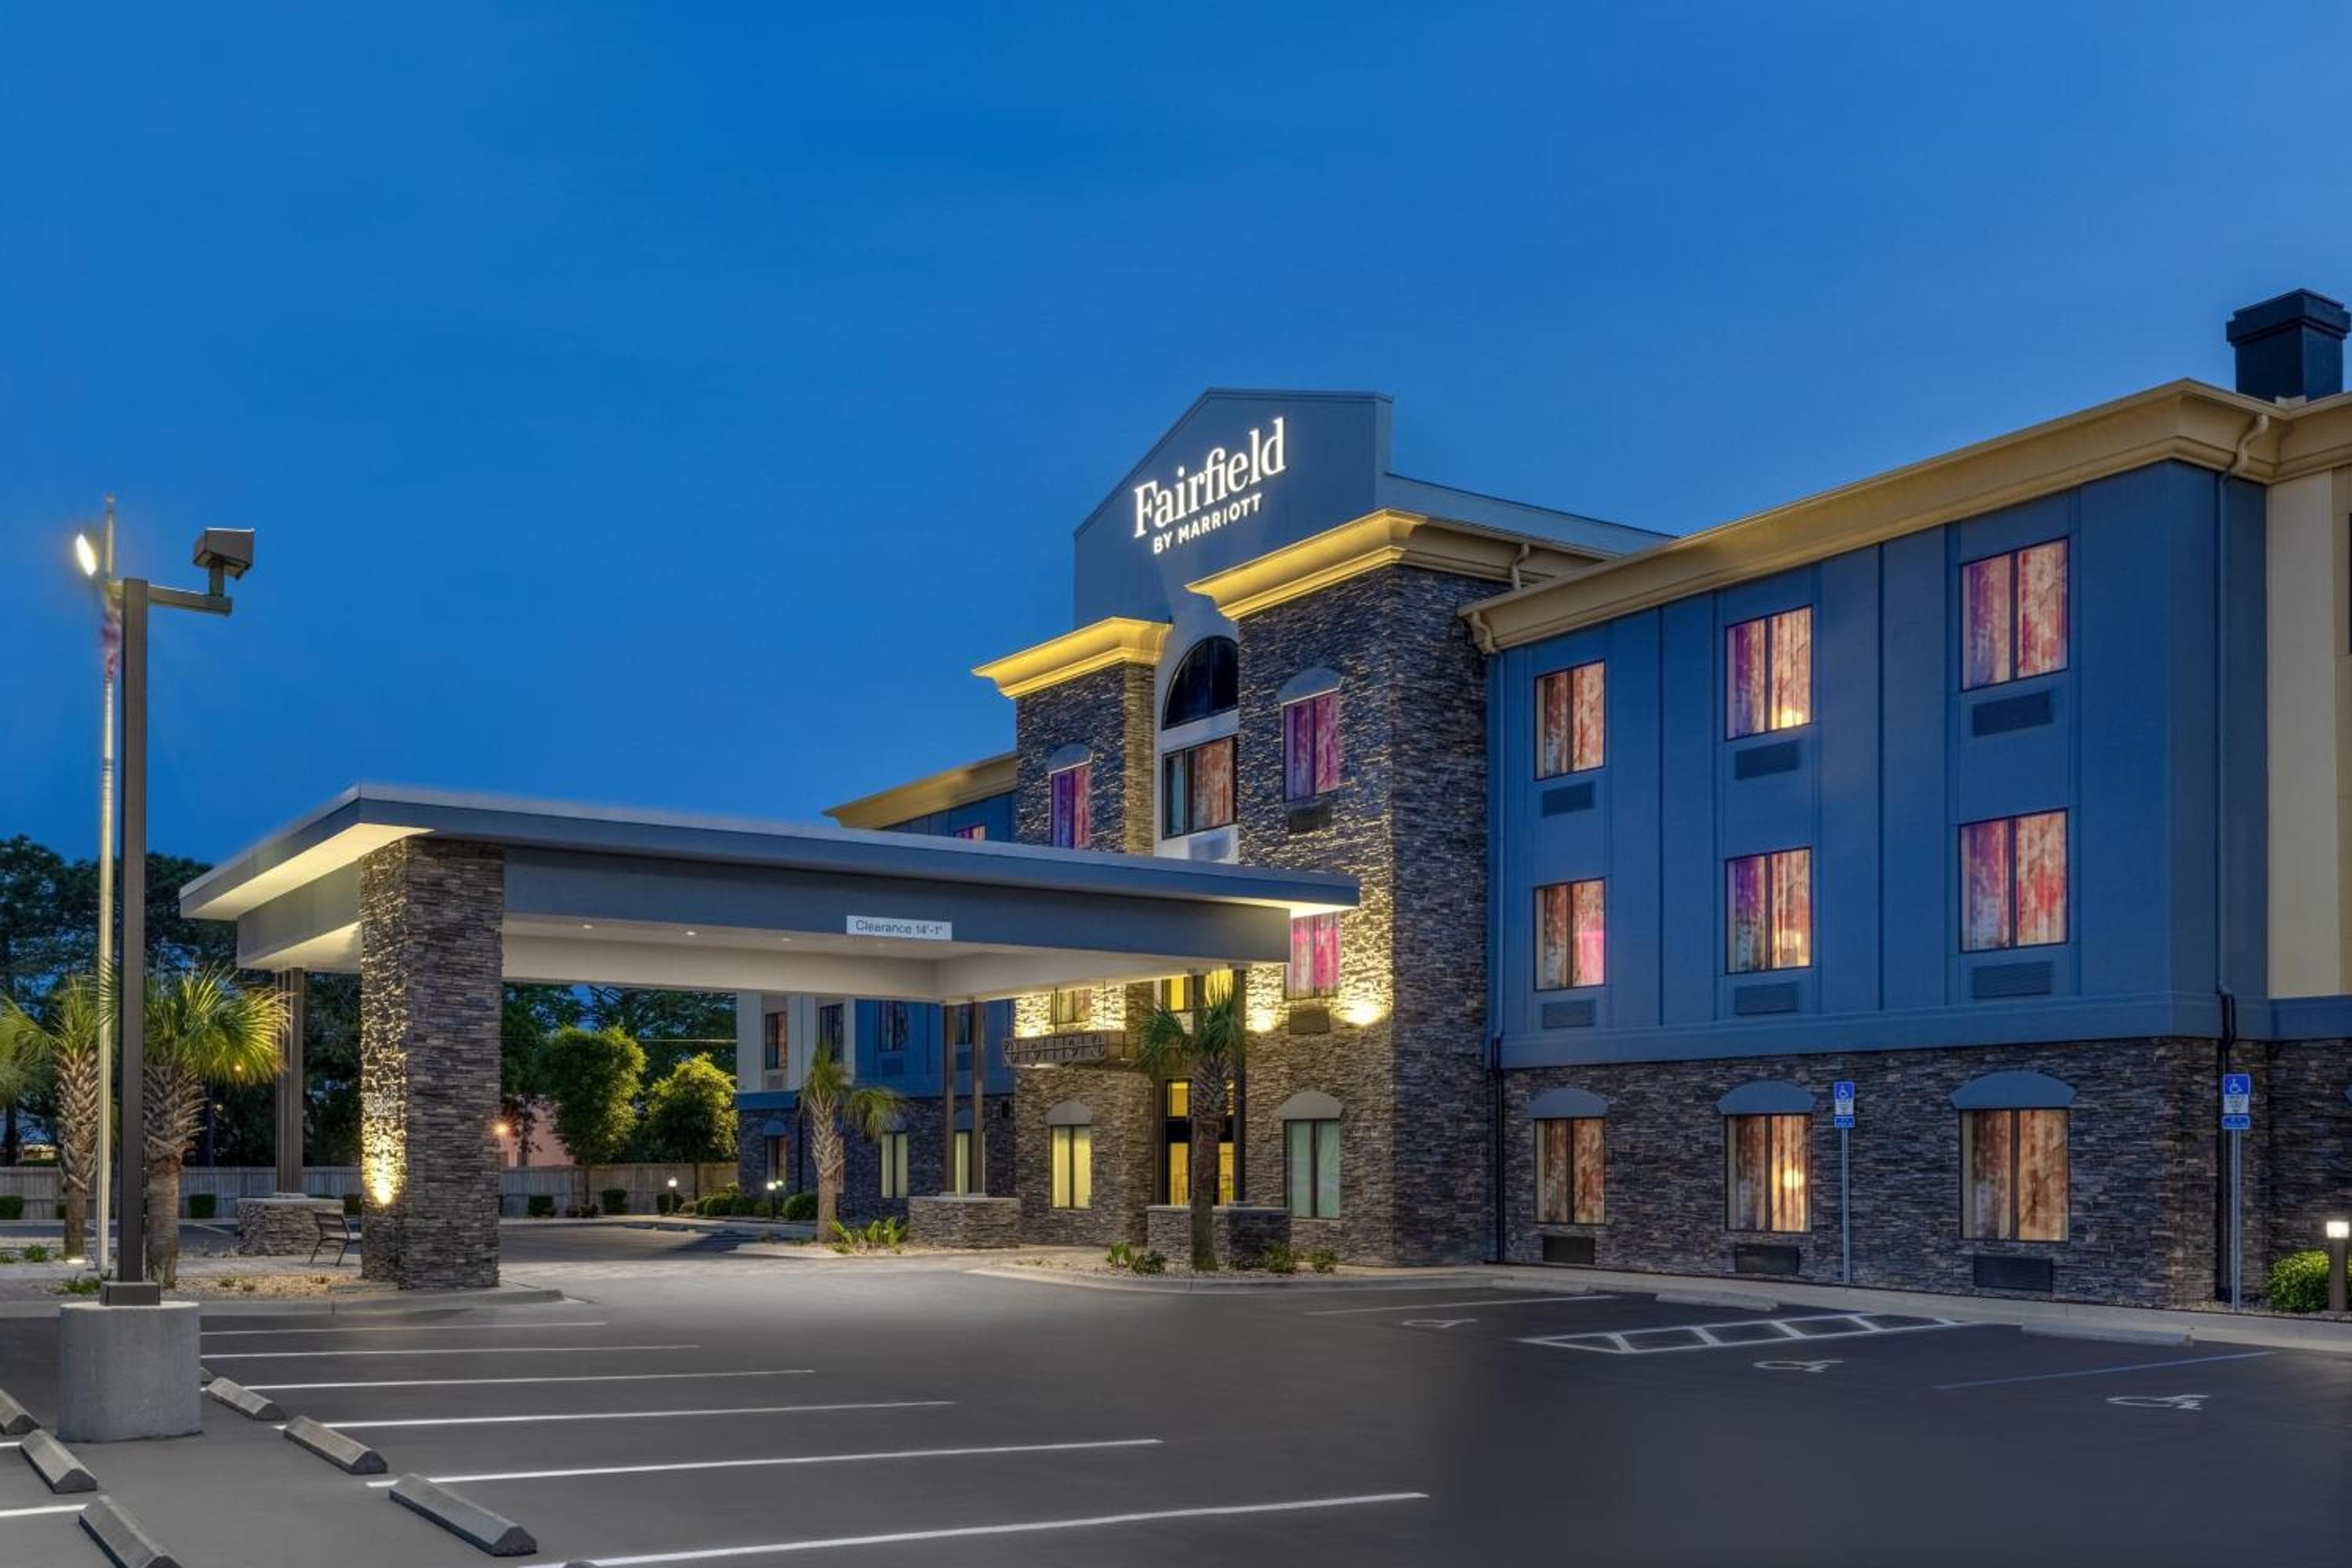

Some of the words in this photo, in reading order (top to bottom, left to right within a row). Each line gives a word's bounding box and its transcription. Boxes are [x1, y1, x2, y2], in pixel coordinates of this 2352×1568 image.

[1134, 416, 1287, 538] Fairfield
[1153, 532, 1173, 554] BY
[1178, 493, 1262, 543] MARRIOTT
[855, 919, 912, 935] Clearance
